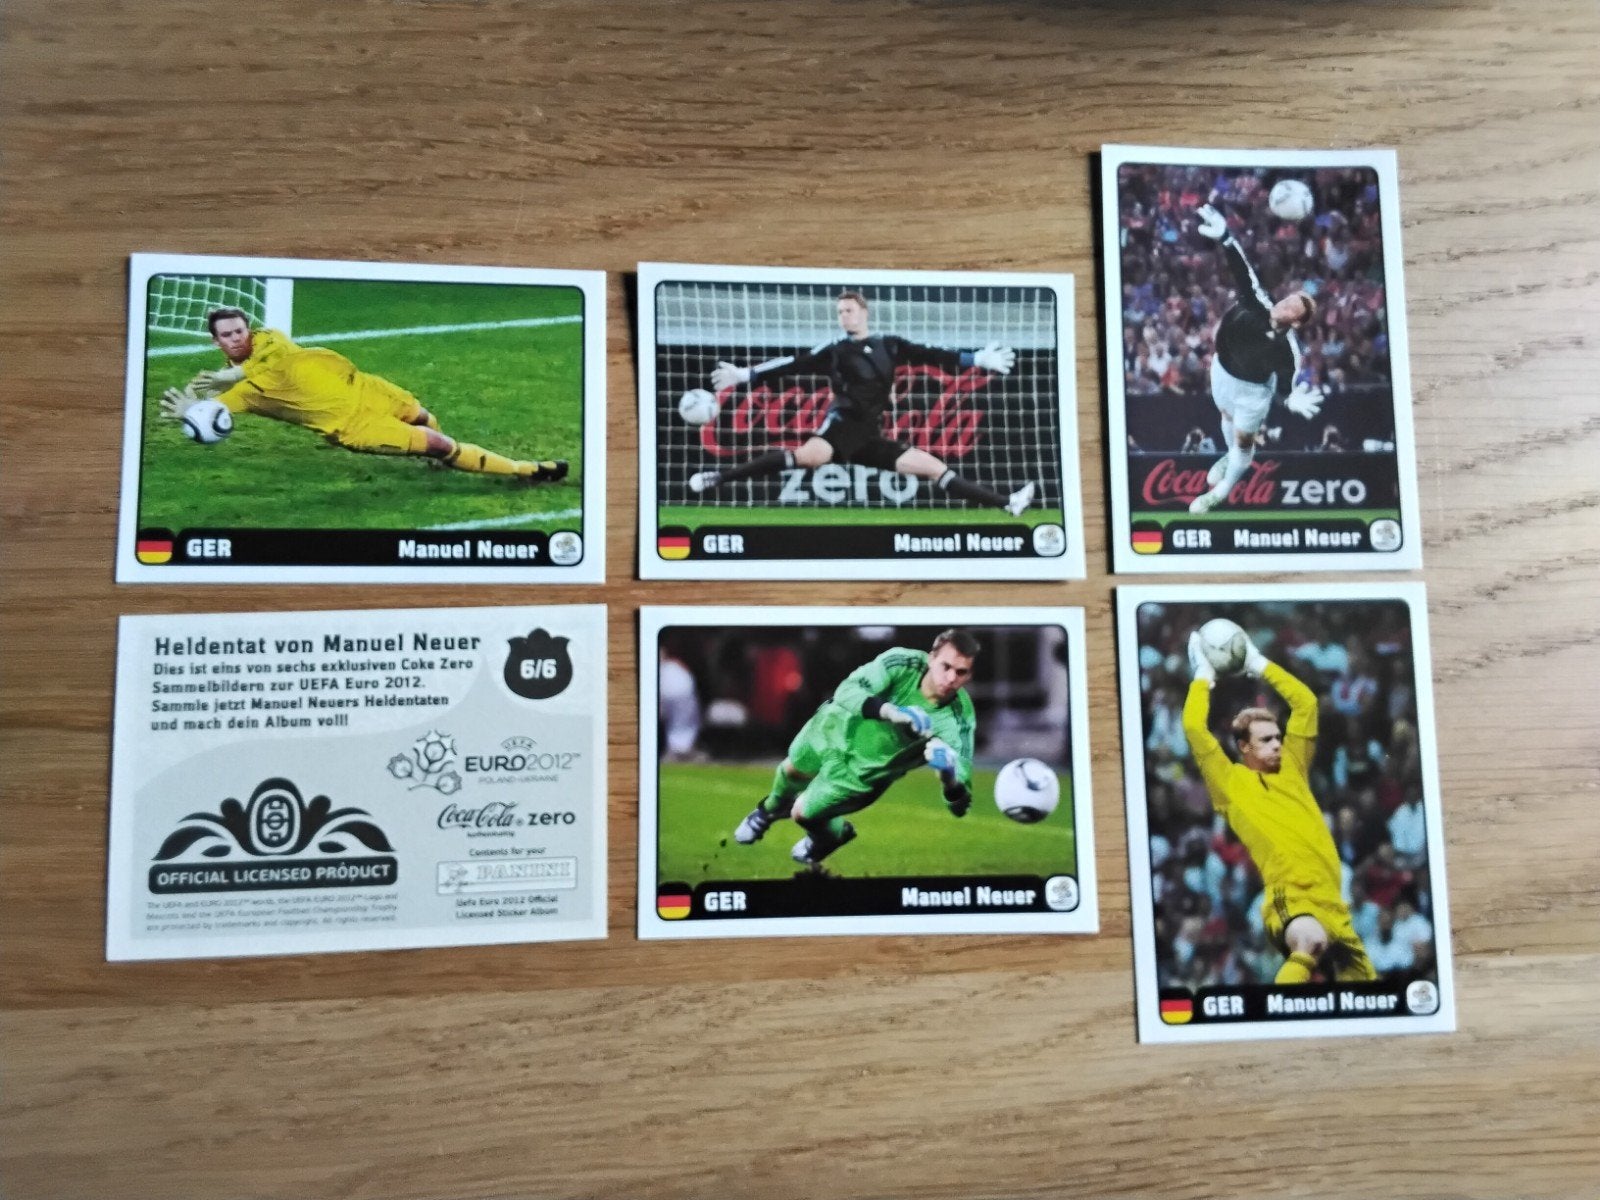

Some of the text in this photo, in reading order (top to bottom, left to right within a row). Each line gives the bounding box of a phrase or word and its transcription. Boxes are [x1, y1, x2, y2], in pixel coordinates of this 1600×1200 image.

[778, 463, 919, 503] zero
[1281, 478, 1367, 504] zero
[186, 538, 232, 557] GER
[703, 534, 744, 554] GER
[894, 533, 1024, 553] Manuel Neuer
[1172, 529, 1212, 548] GER
[1233, 528, 1362, 548] Manuel Neuer
[398, 539, 539, 559] Manuel Neuer
[155, 633, 481, 656] Heldentat von Manuel Neuer
[153, 657, 474, 675] Dies ist eins von sechs exklusiven Coke Zero
[520, 658, 557, 680] 6/6
[153, 676, 426, 693] Sammelbildern zur UEFA Euro 2012.
[152, 695, 450, 713] Sammle jetzt Manuel Neuers Heldentaten
[151, 713, 349, 730] und mach dein Album voll!
[527, 811, 576, 826] zero
[157, 870, 229, 886] OFFICIAL
[233, 866, 312, 884] LICENSED
[476, 861, 571, 880] PANINI
[704, 891, 747, 912] GER
[902, 887, 1037, 908] Manuel Neuer
[1203, 995, 1244, 1016] GER
[1267, 992, 1398, 1014] Manuel Neuer
